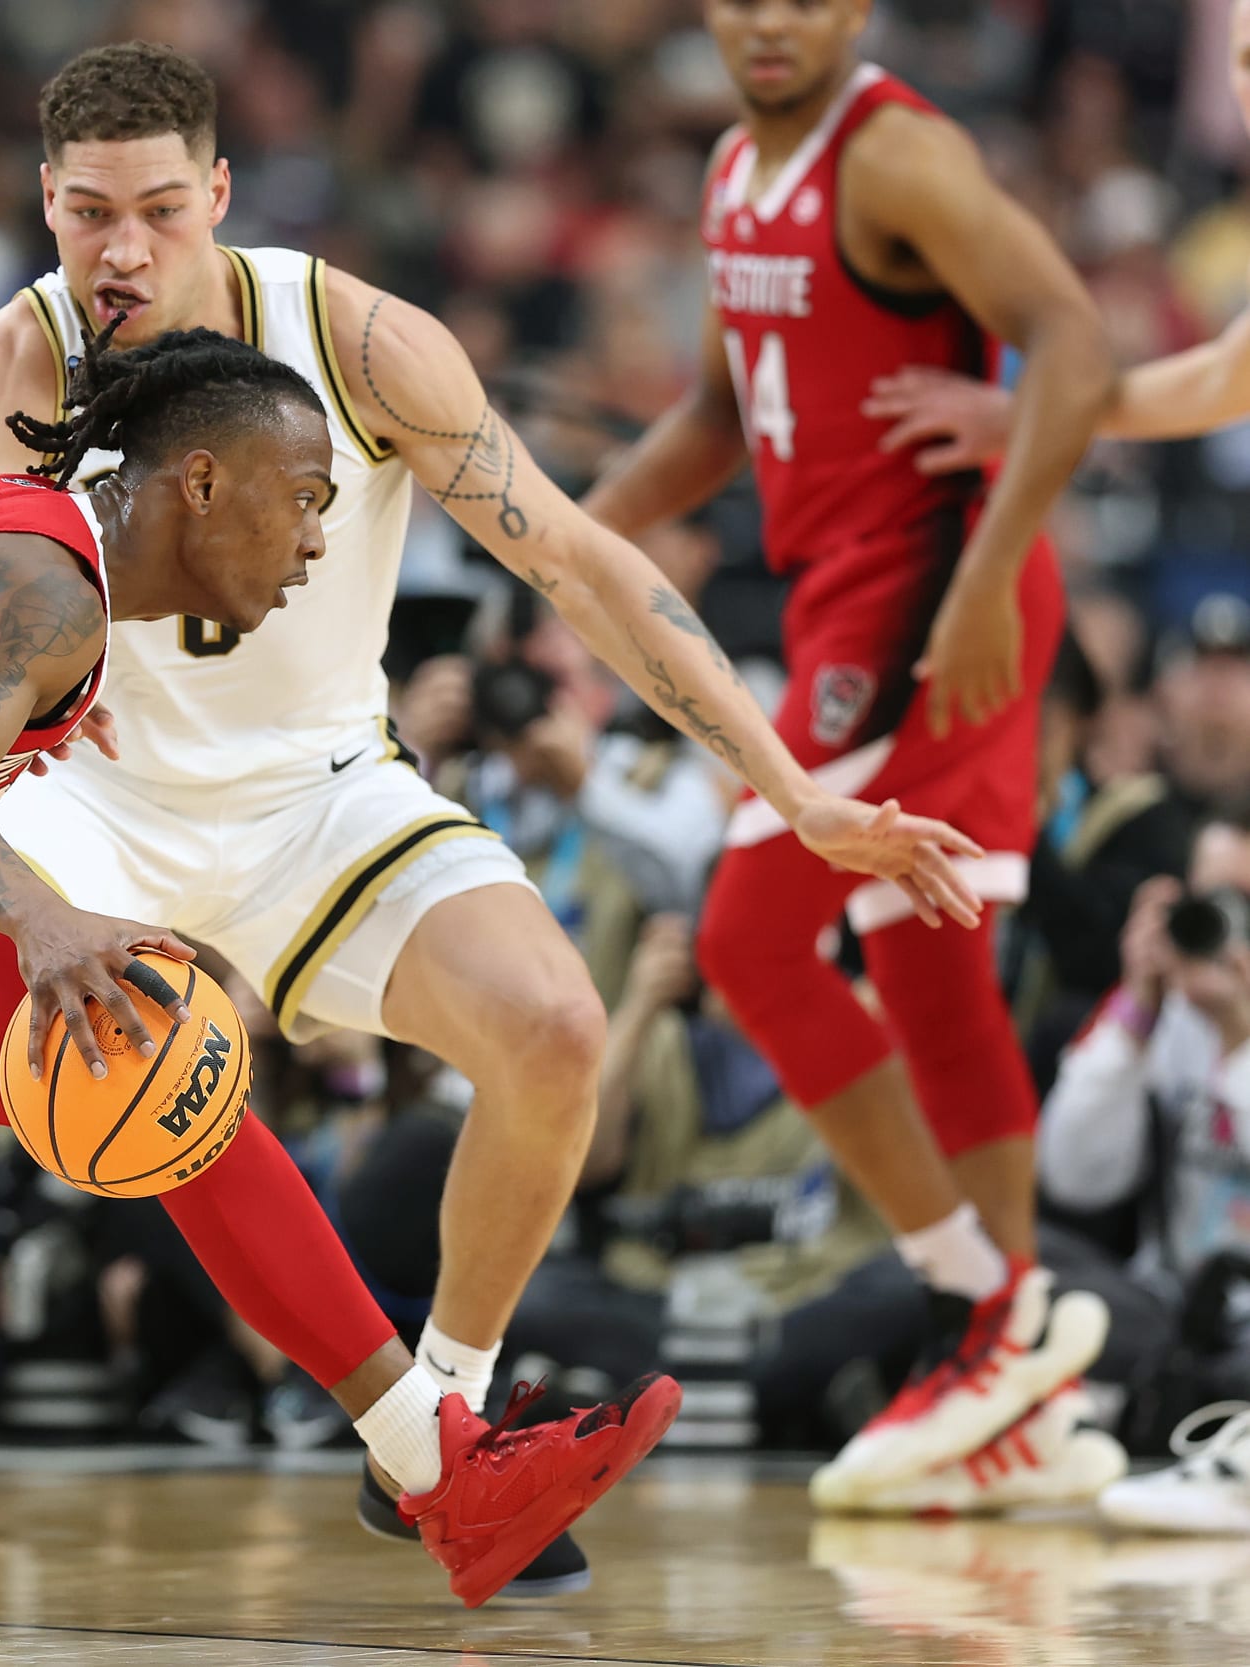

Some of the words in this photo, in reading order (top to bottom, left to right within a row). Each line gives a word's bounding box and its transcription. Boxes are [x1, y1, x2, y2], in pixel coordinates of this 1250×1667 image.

[724, 253, 813, 318] STATE
[724, 328, 797, 462] 14
[149, 1092, 174, 1116] BALL
[156, 1020, 232, 1139] NCAA
[172, 1061, 192, 1092] GAME
